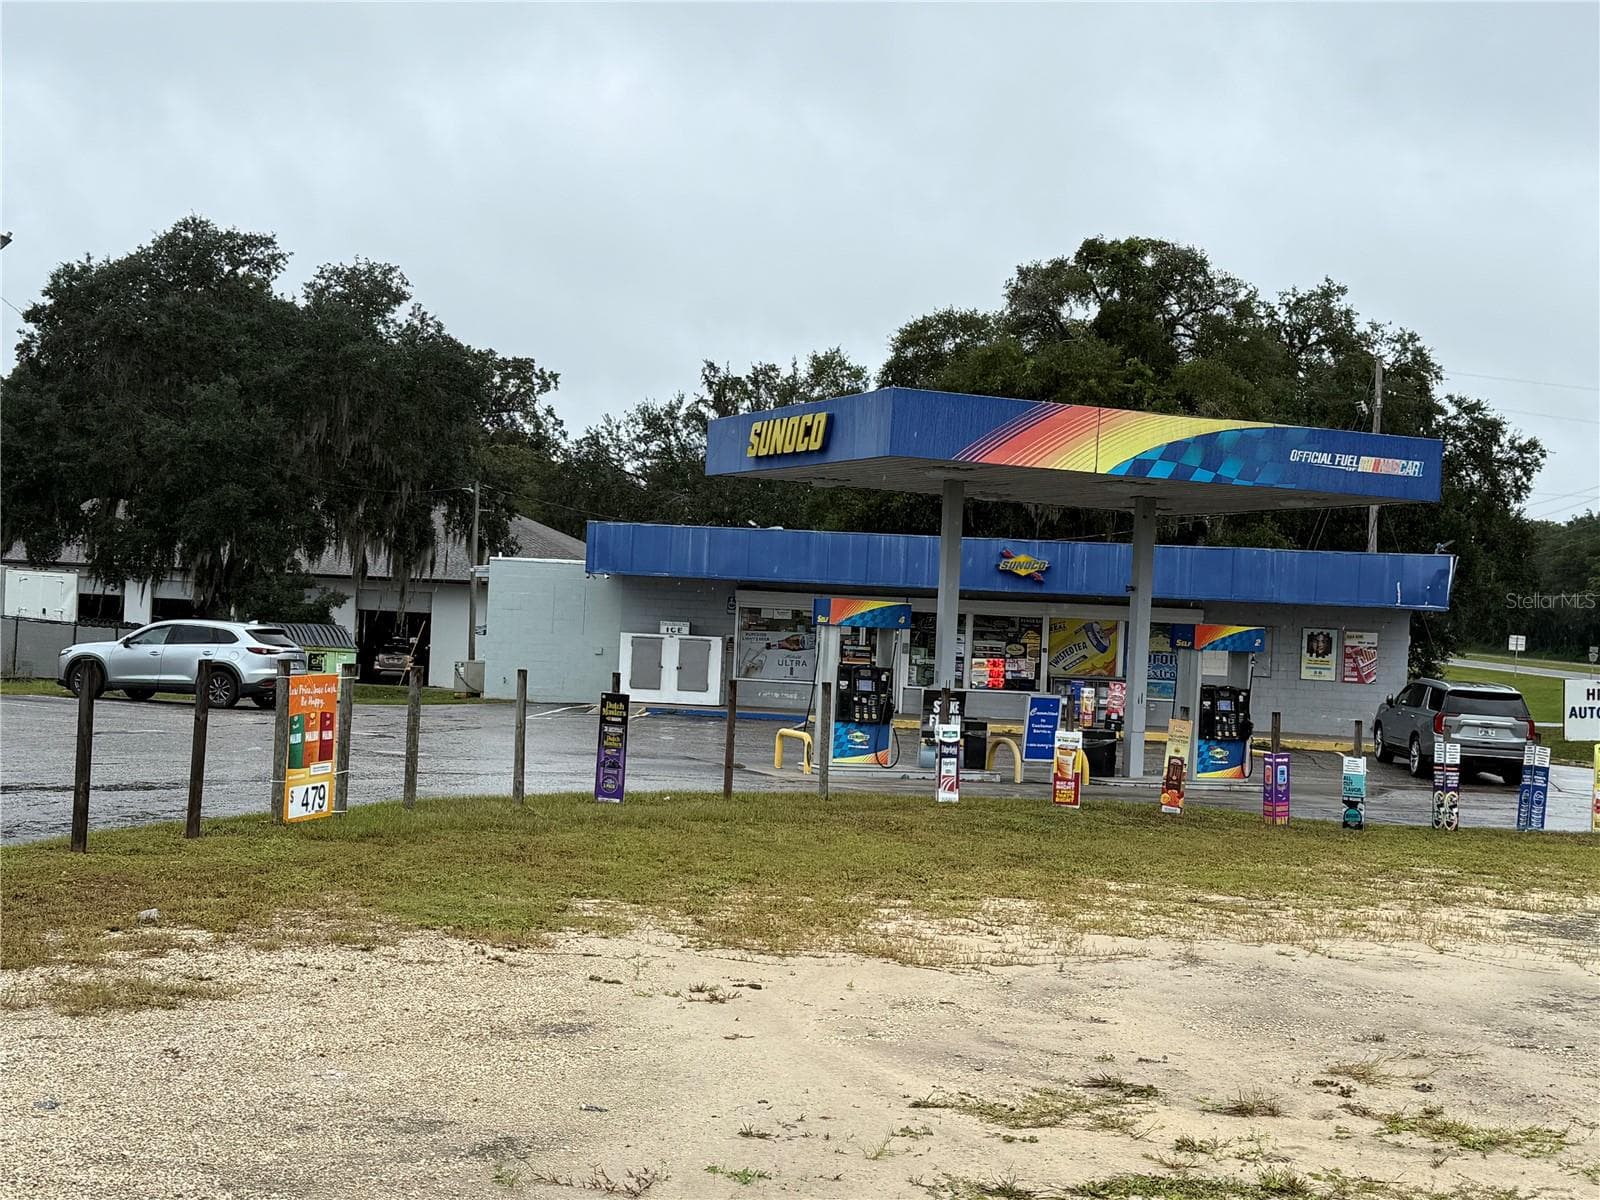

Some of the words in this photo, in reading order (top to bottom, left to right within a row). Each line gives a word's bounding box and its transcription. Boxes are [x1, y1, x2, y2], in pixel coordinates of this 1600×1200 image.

[747, 412, 828, 457] SUNOCO
[1290, 449, 1332, 465] OFFICIAL
[1334, 454, 1359, 468] FUEL
[1380, 459, 1421, 477] NASCAR
[1001, 560, 1048, 570] SUNOCO
[666, 626, 683, 634] ICE
[777, 659, 808, 667] ULTRA
[290, 790, 294, 803] $
